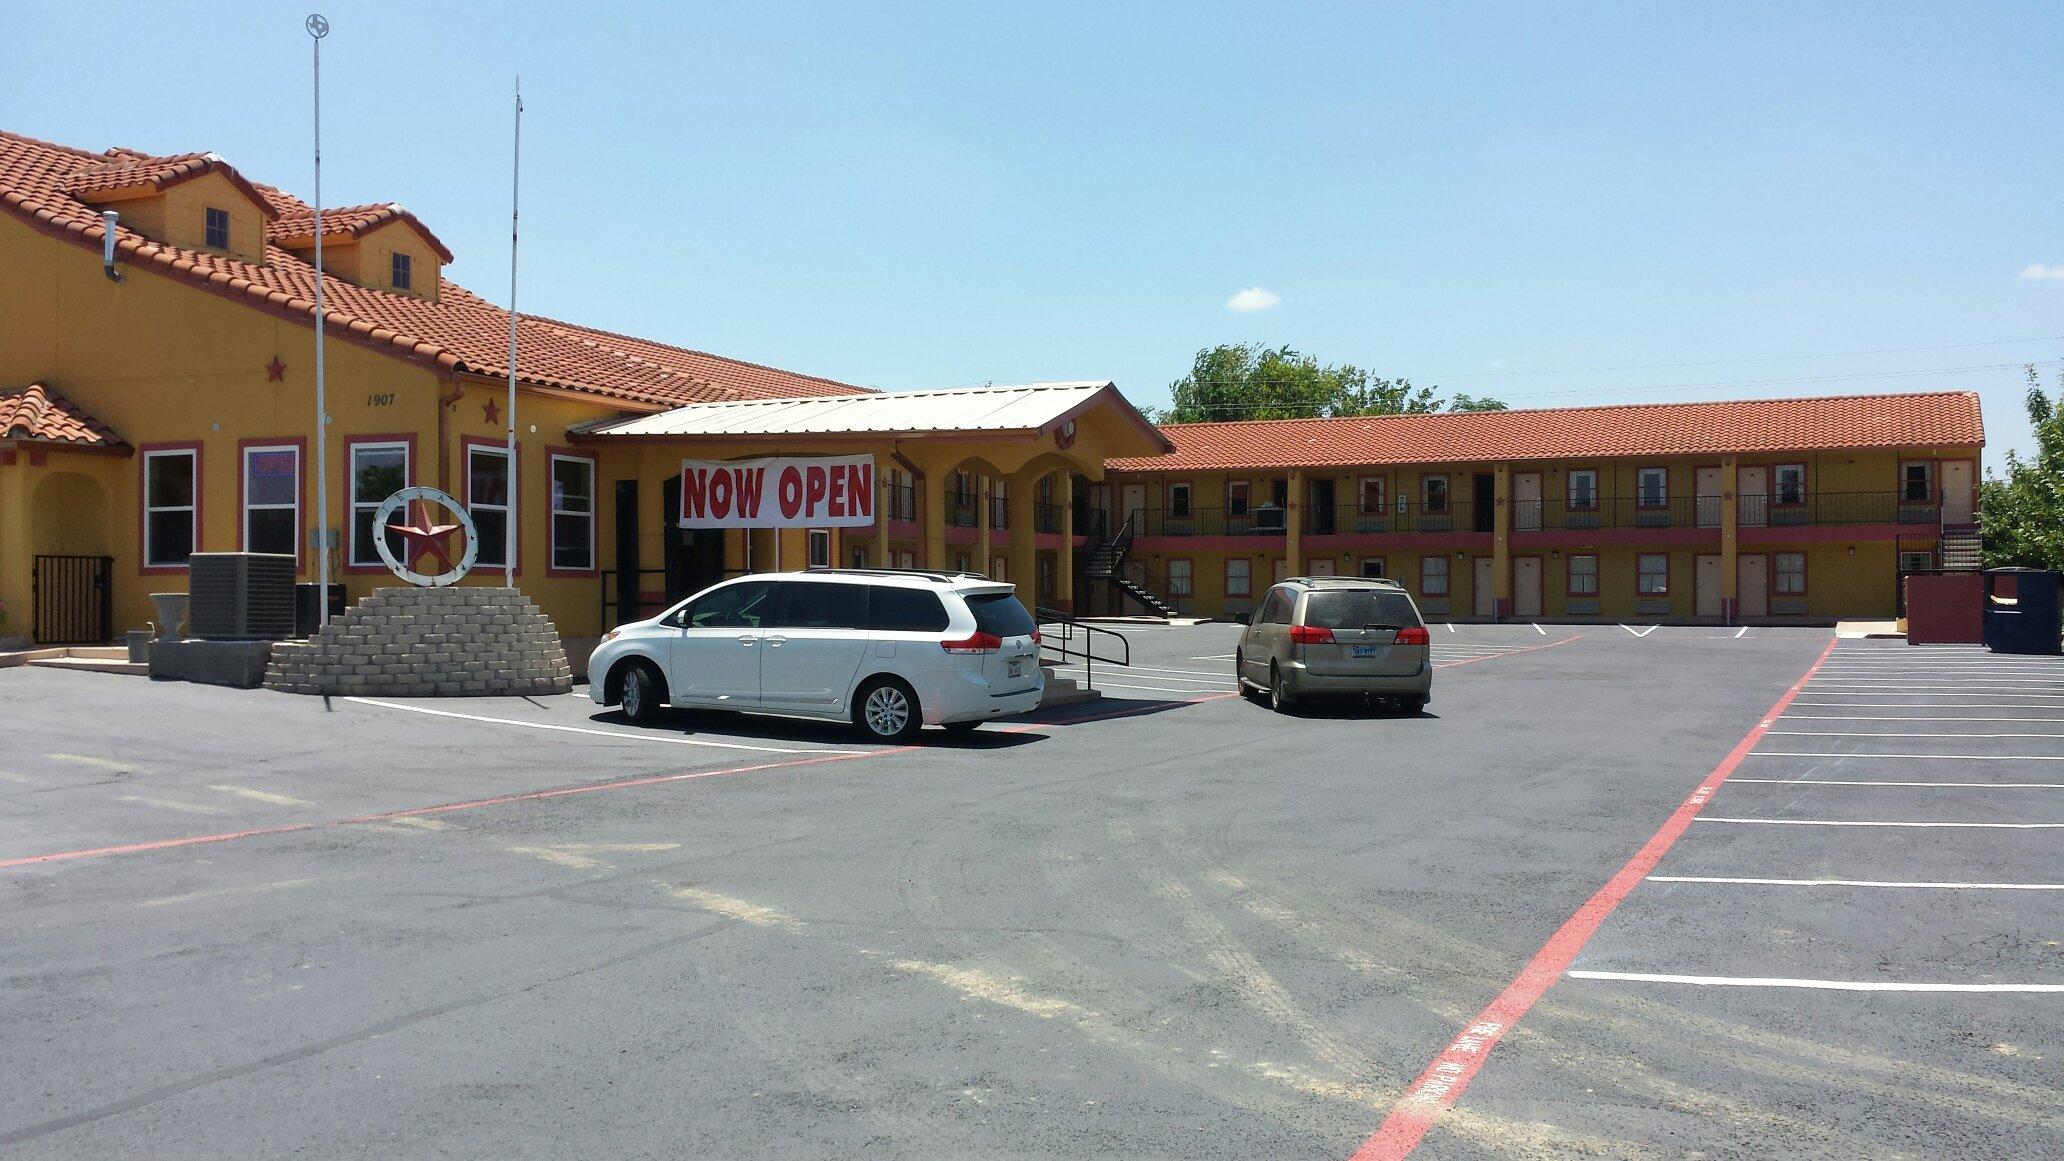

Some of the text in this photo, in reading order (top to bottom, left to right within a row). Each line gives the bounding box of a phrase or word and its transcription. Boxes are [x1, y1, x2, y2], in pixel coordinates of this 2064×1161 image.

[367, 394, 395, 406] 1907
[683, 463, 872, 520] NOW OPEN
